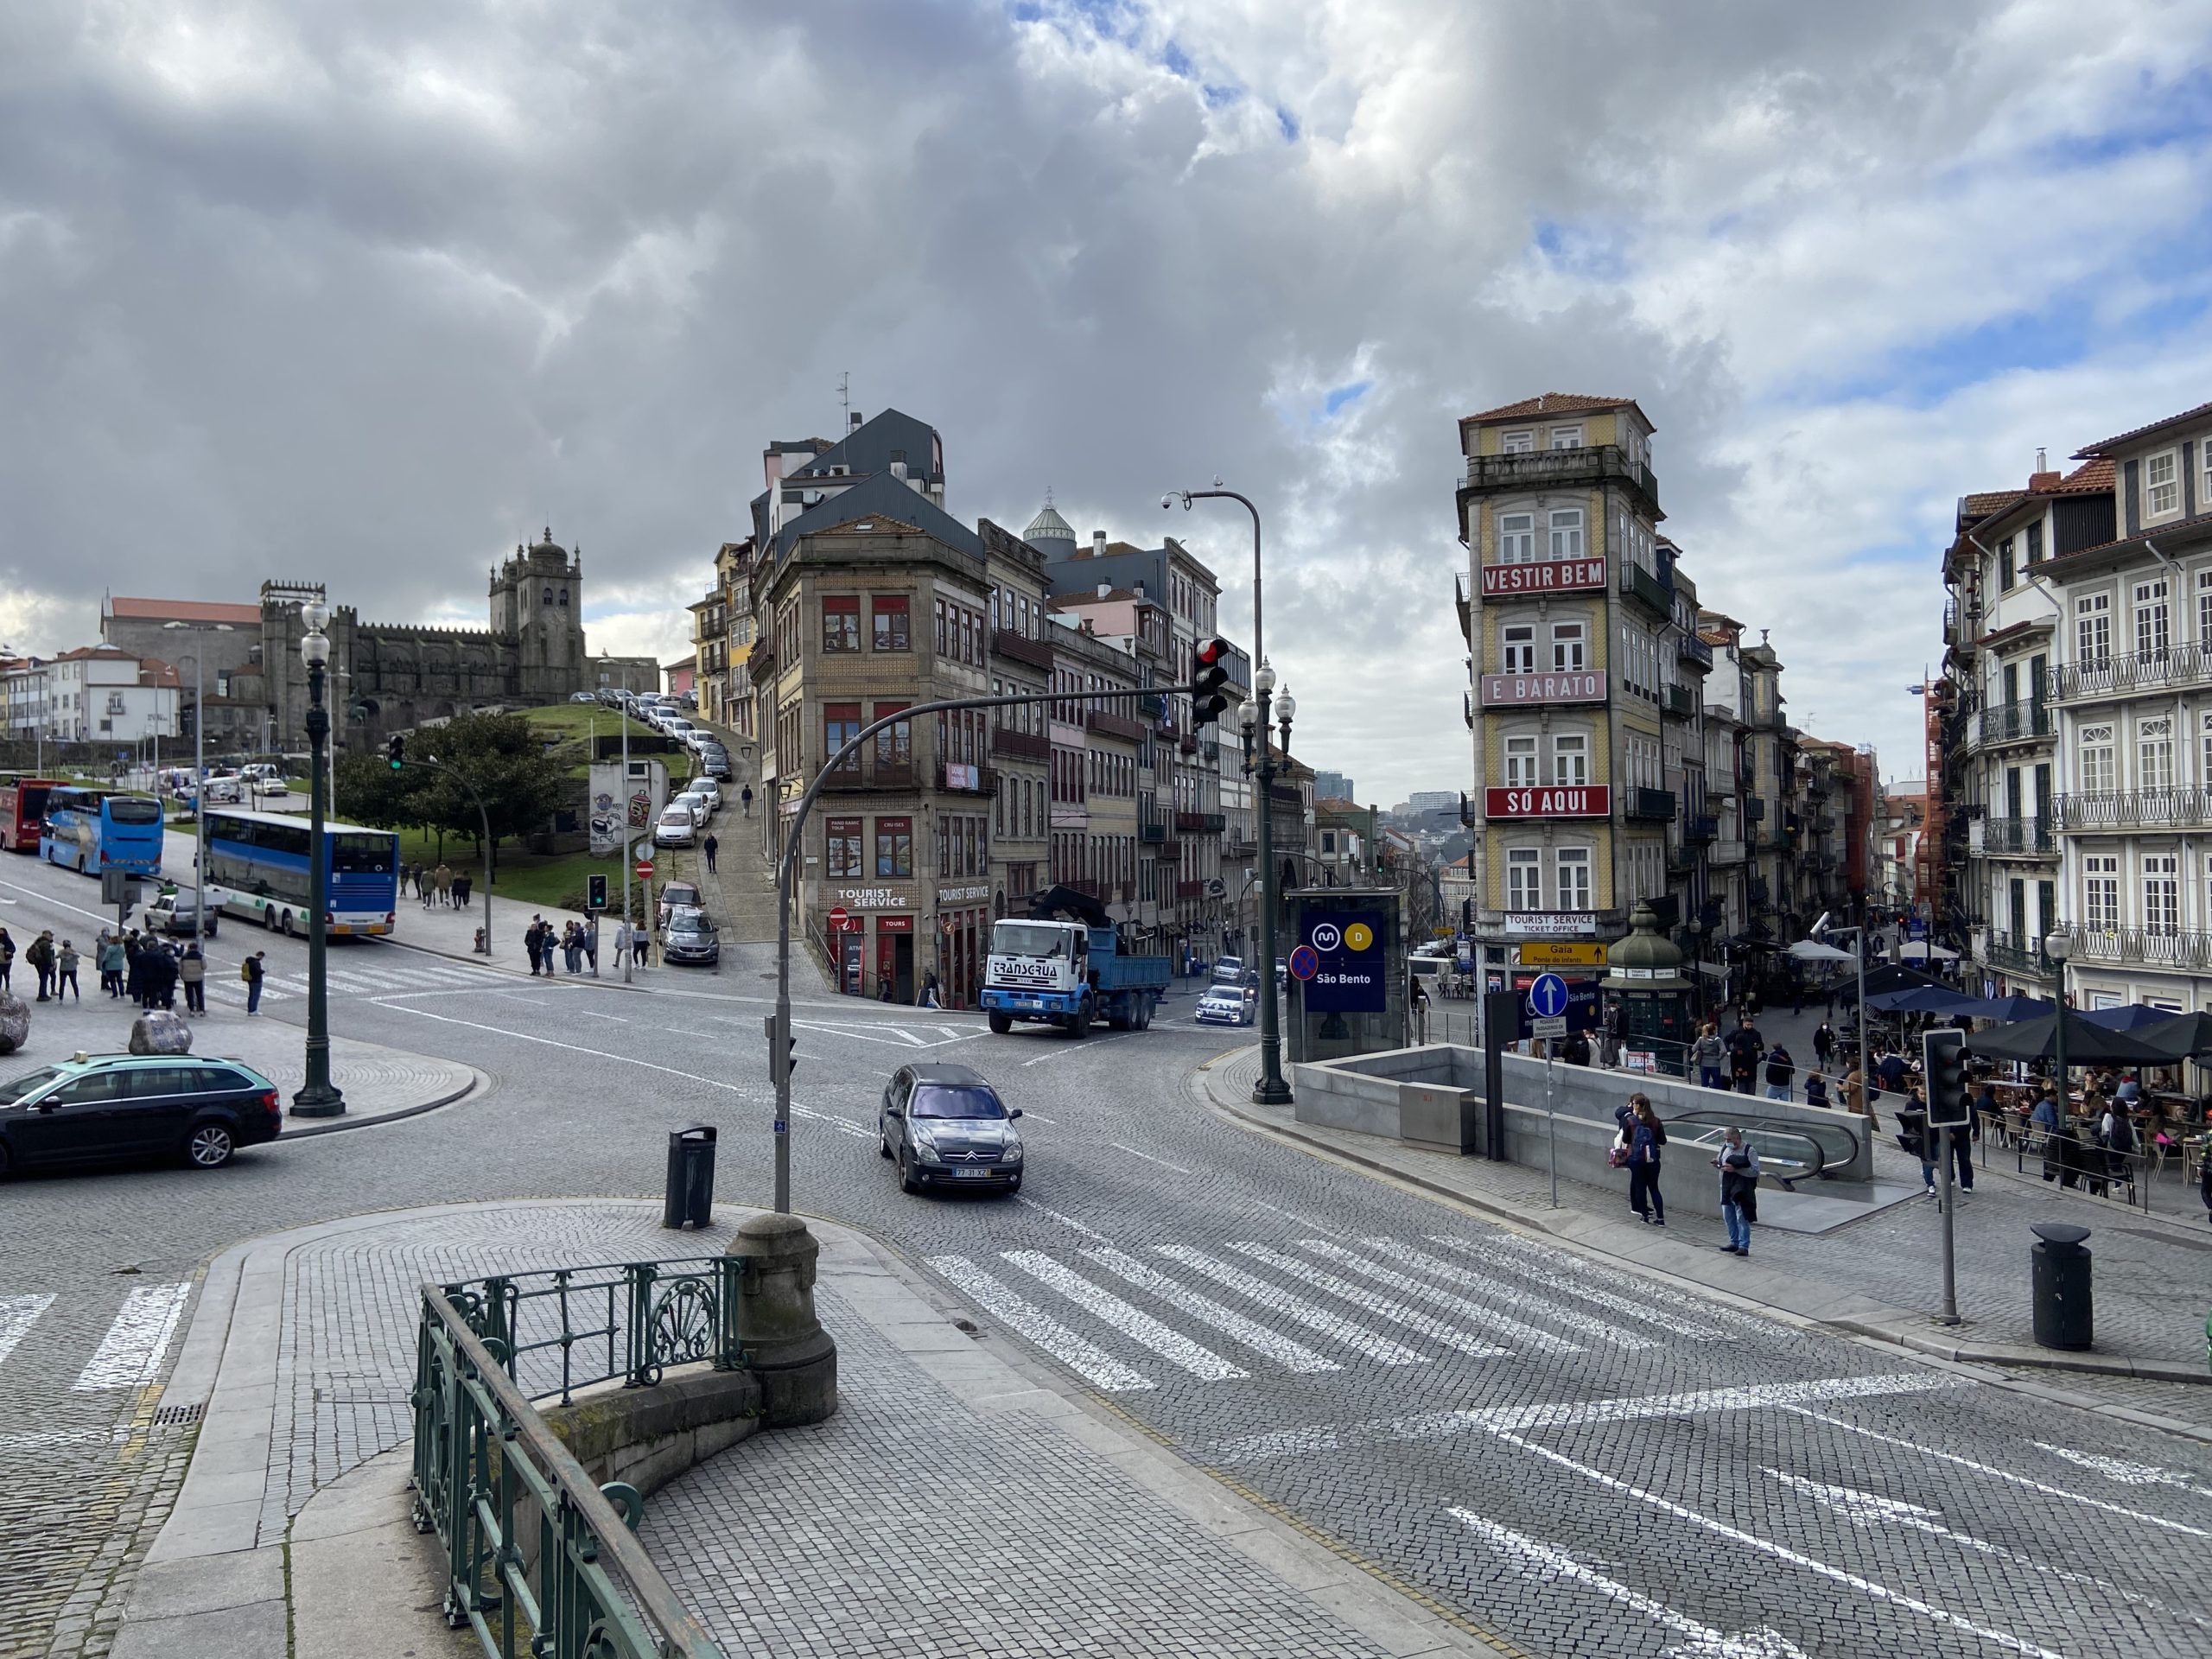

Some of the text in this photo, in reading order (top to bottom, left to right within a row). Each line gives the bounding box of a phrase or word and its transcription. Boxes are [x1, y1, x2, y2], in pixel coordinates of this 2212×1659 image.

[1484, 562, 1602, 590] VESTIR BEM
[1492, 675, 1596, 700] E BARATO
[1507, 788, 1587, 812] SÓ AQUI
[838, 888, 893, 899] TOURIST
[938, 885, 988, 902] TOURIST SERVICE
[854, 897, 906, 907] SERVICE
[1509, 915, 1592, 924] TOURIST SERVICE
[1355, 932, 1363, 942] D
[1550, 944, 1573, 954] Gaia
[994, 962, 1058, 977] TRANSGRUA
[1316, 973, 1371, 984] São Bento
[1569, 991, 1595, 1002] São Bento
